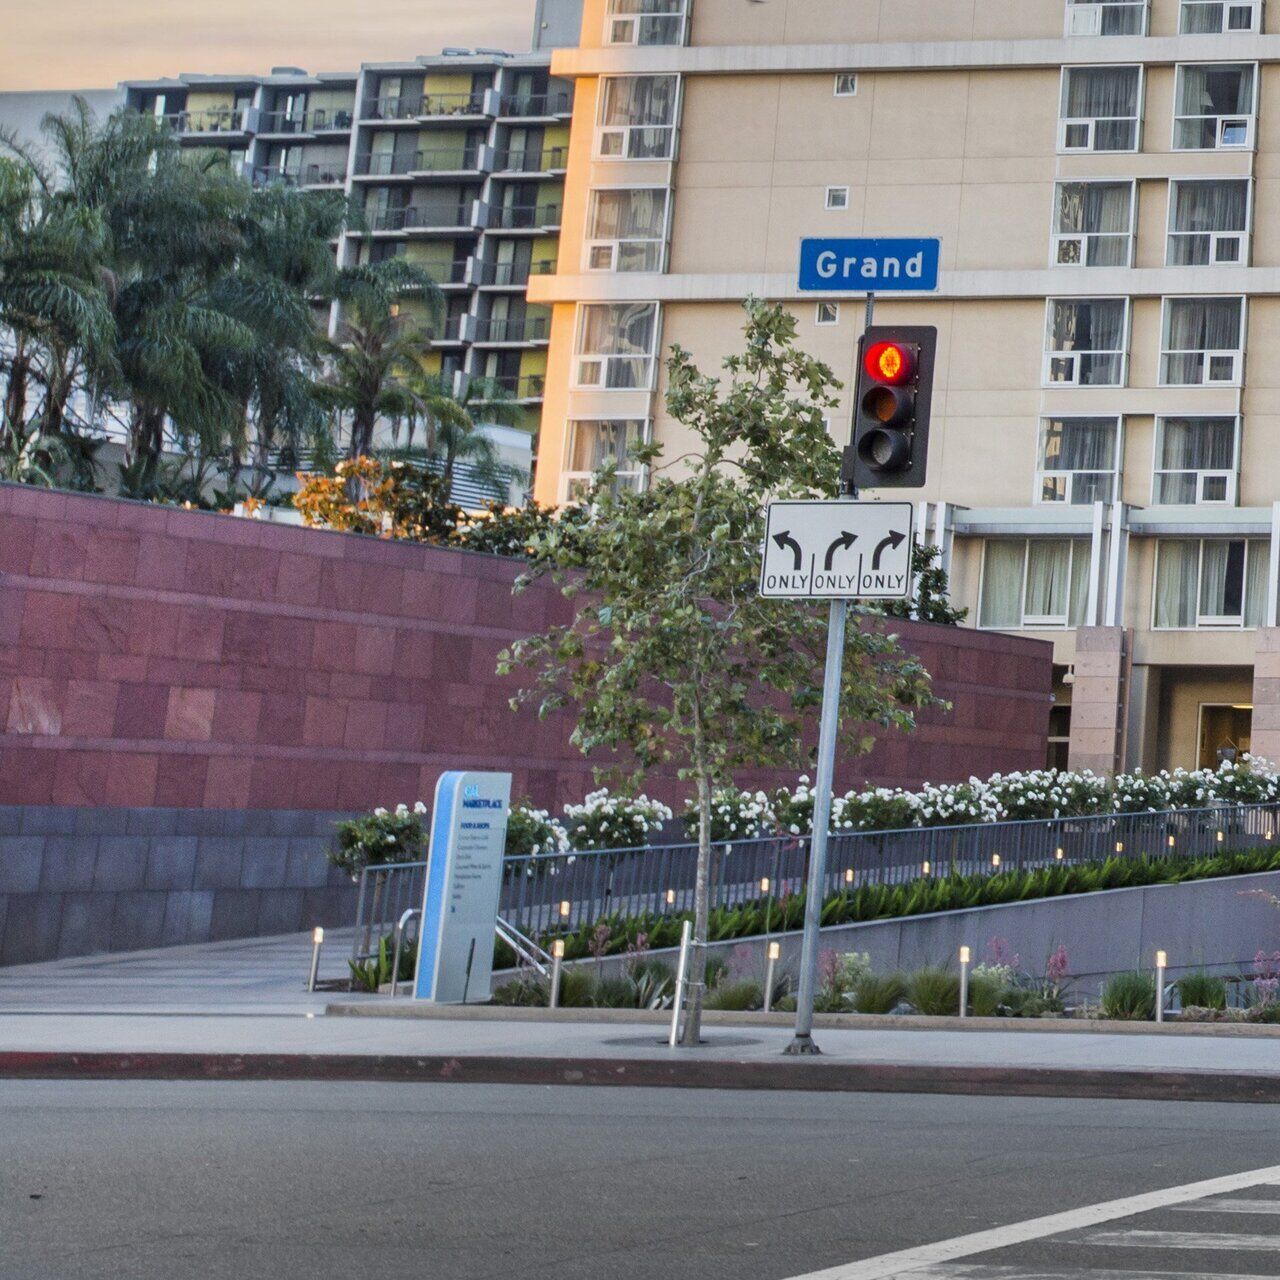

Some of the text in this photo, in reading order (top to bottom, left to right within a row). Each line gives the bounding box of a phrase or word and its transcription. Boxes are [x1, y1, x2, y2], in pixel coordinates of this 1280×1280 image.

[816, 250, 924, 278] Grand
[766, 574, 905, 590] ONLY ONLY ONLY
